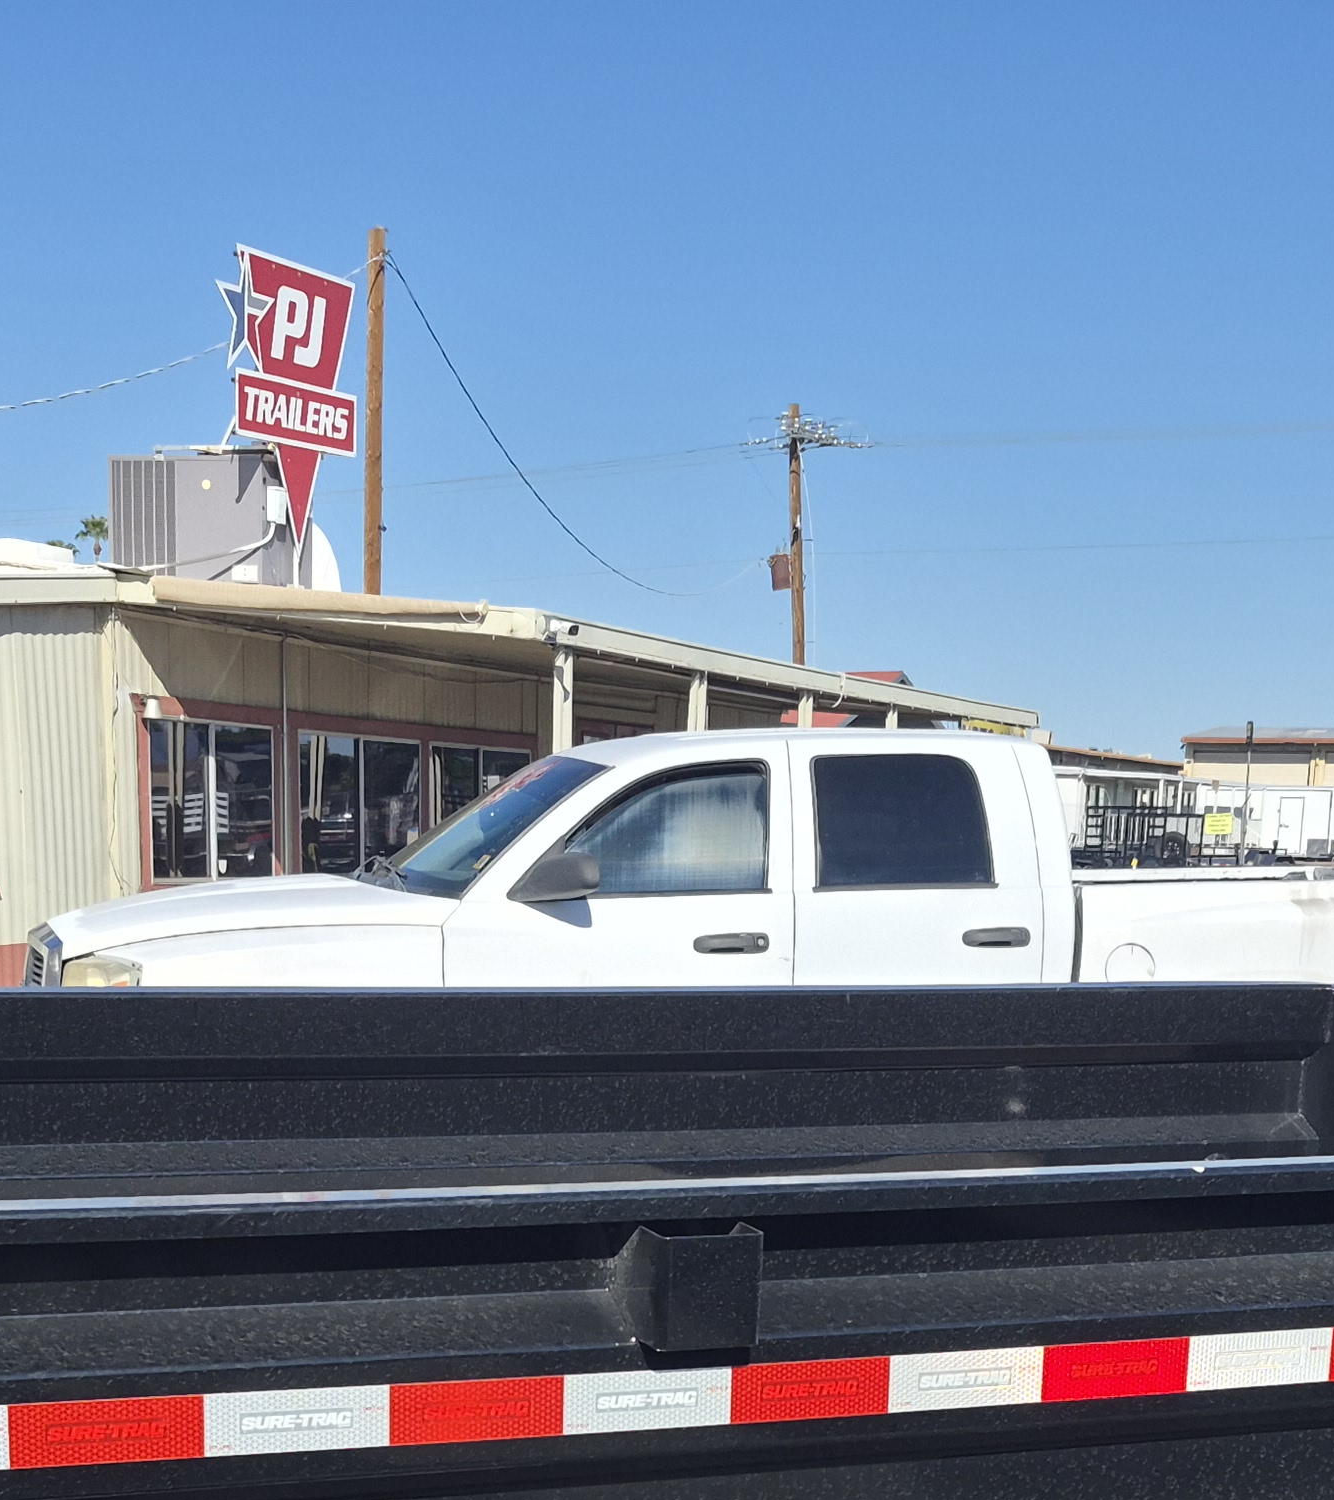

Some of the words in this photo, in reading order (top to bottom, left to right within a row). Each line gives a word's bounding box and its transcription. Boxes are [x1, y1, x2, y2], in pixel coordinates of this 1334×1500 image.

[270, 285, 327, 368] PJ
[243, 385, 349, 440] TRAILERS
[919, 1369, 1012, 1389] SURE-TRAC
[597, 1389, 697, 1411] SURE-TRAC
[48, 1420, 165, 1443] SURE-TRAC
[241, 1410, 352, 1433] SURE-TRAC
